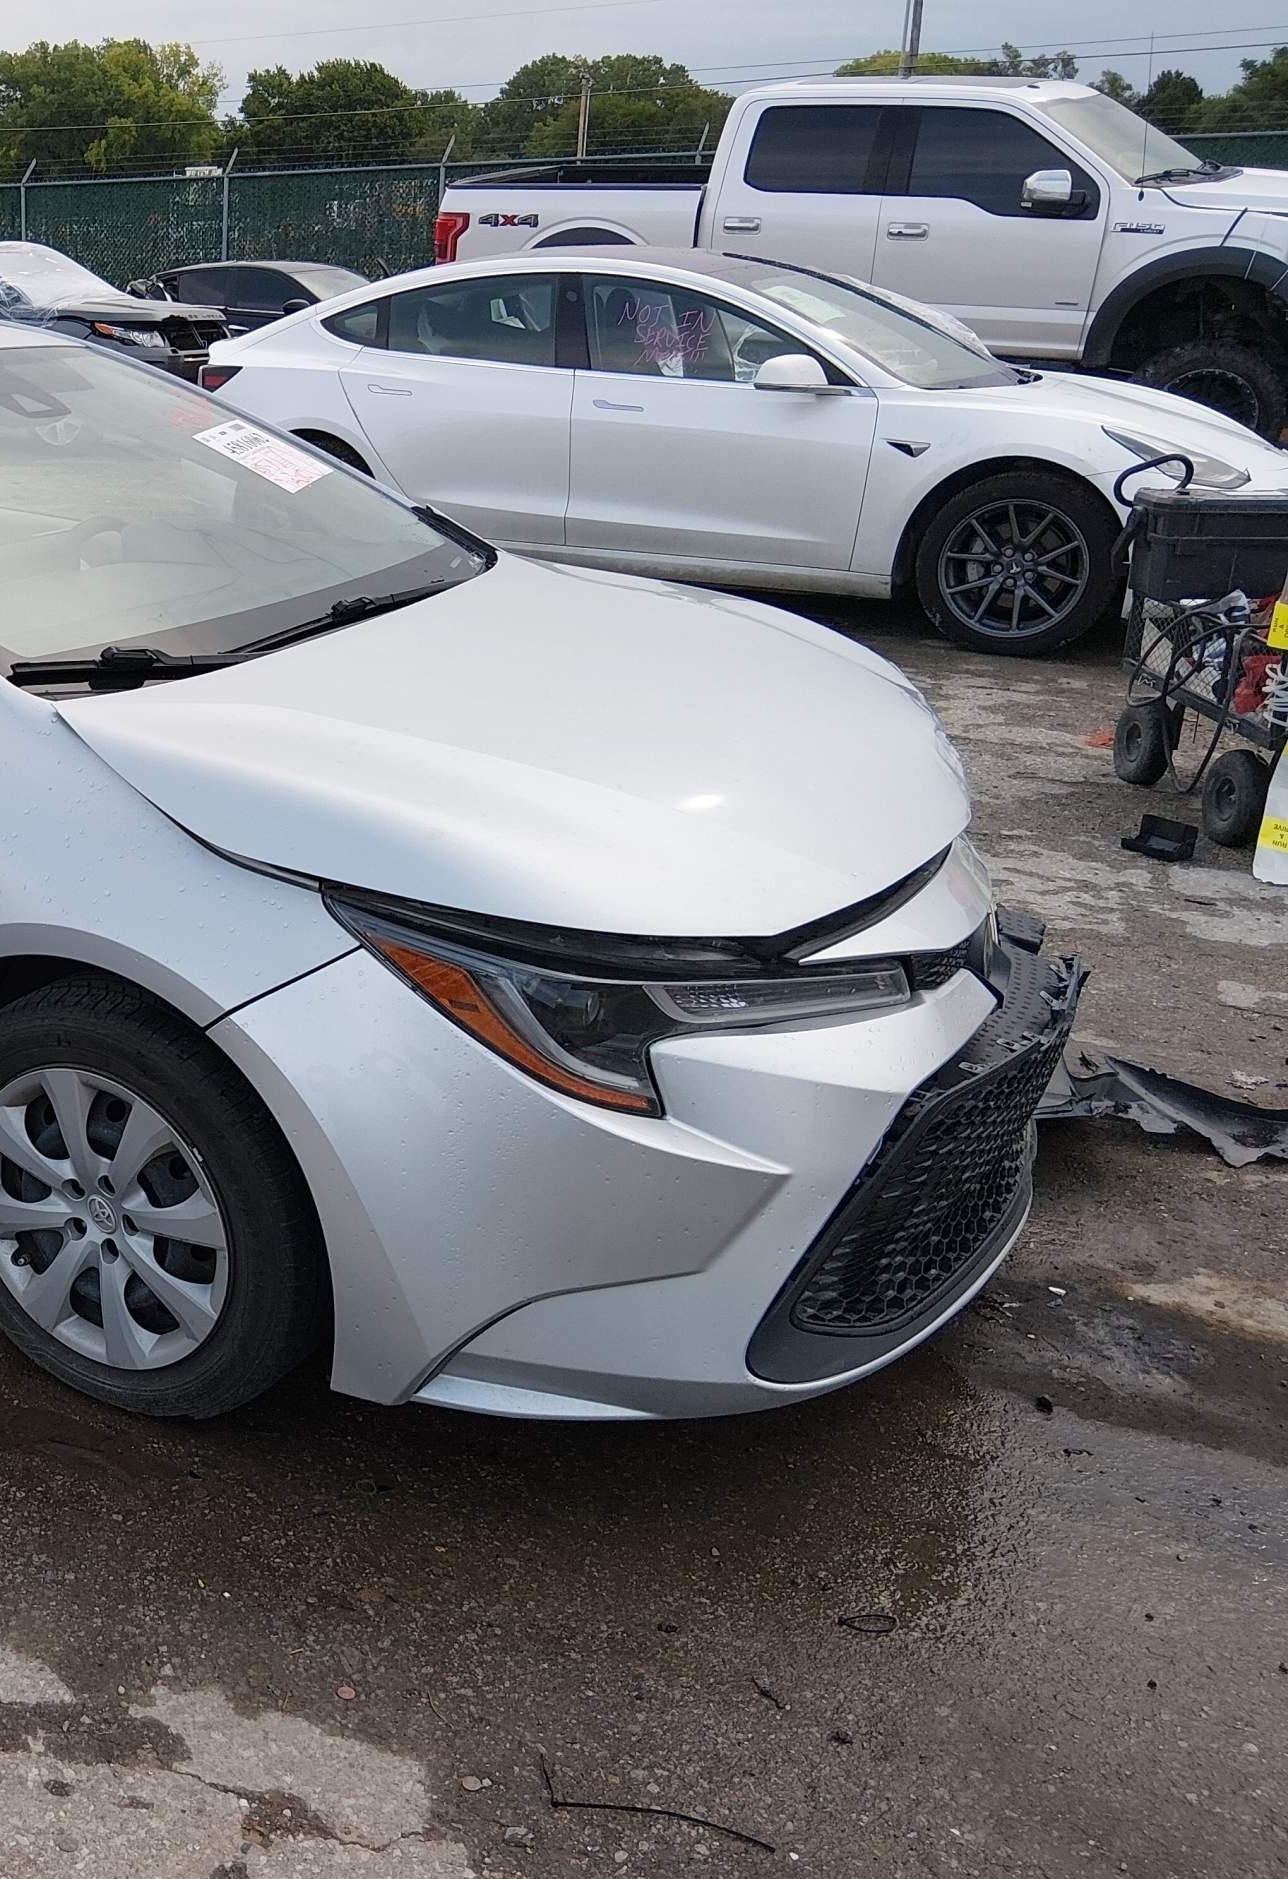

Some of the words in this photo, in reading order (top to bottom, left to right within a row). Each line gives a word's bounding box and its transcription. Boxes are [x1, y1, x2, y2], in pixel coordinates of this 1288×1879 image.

[617, 297, 671, 326] NOT
[676, 310, 717, 332] IN
[634, 324, 712, 351] SERVICE
